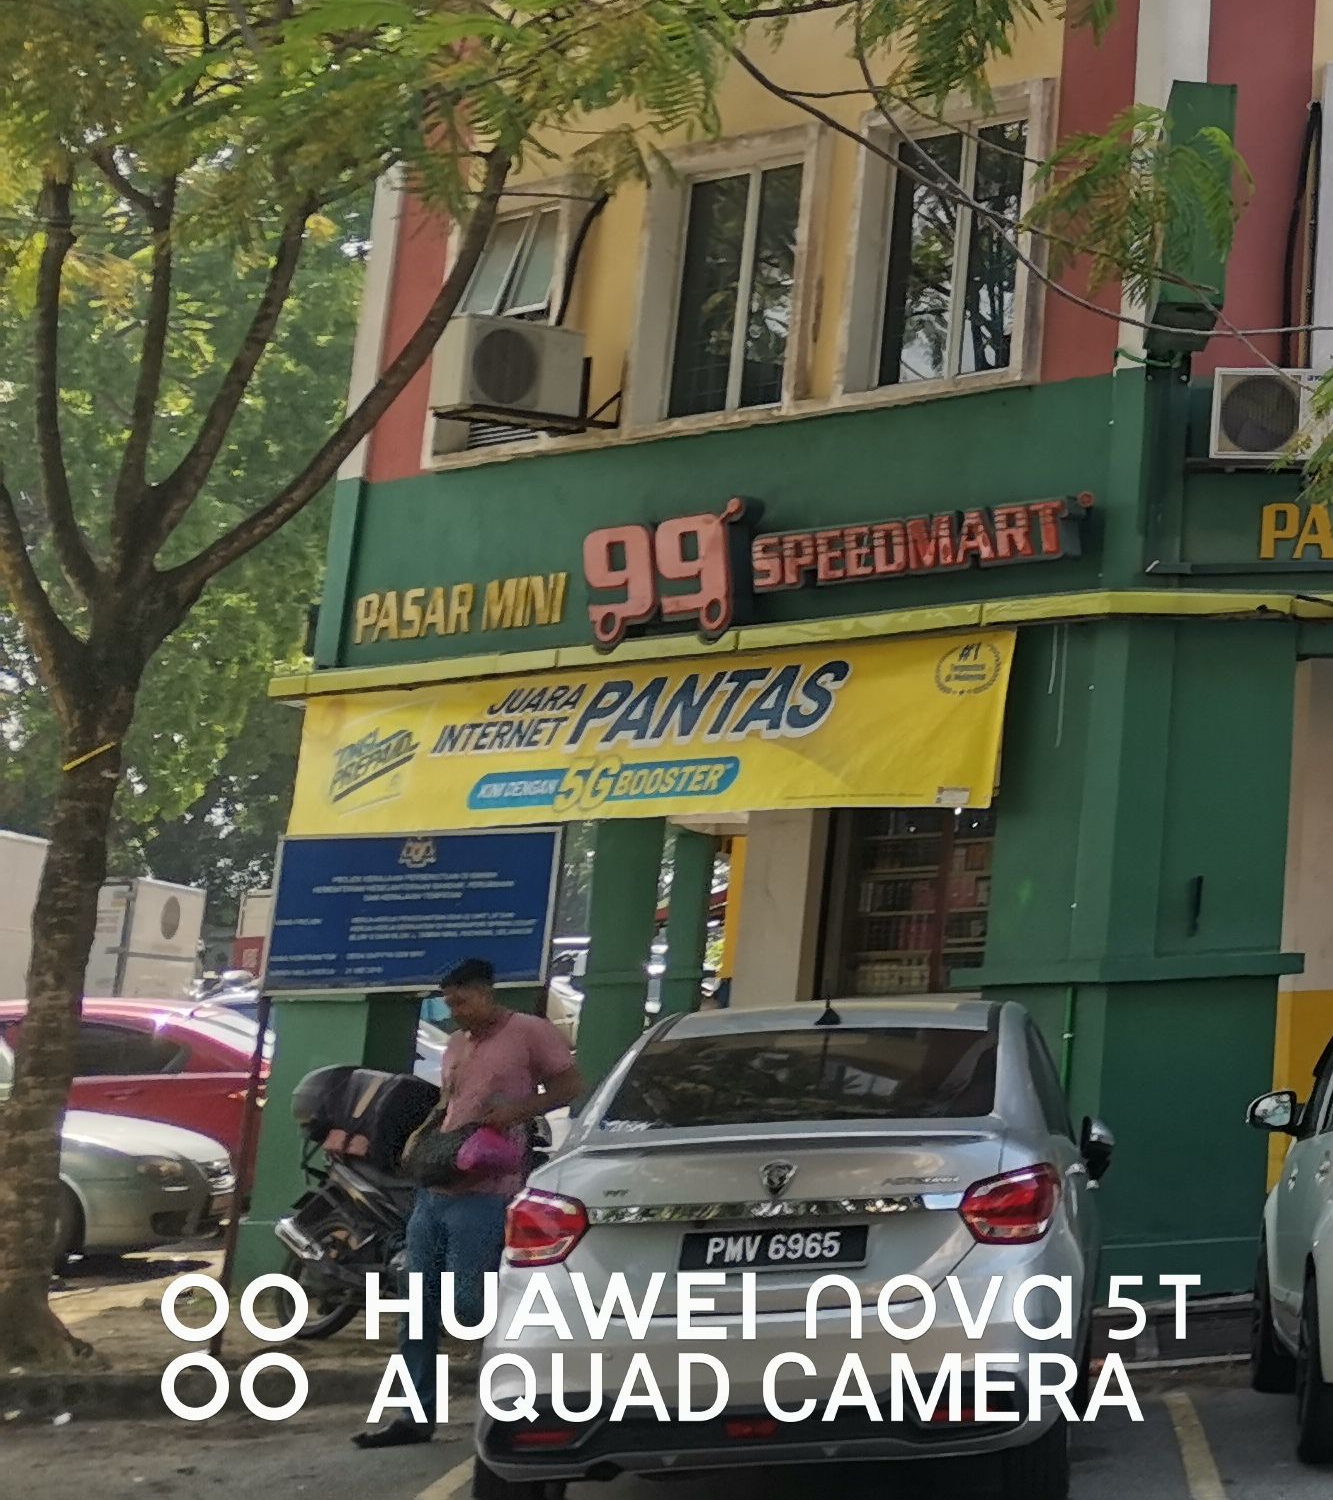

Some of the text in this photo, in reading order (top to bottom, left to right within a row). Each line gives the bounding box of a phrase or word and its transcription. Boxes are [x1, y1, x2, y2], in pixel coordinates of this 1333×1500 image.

[354, 497, 1064, 649] PASAR MINI 99 SPEEDMART
[488, 683, 587, 715] JUARA
[563, 660, 849, 746] PANTAS
[431, 717, 569, 754] INTERNET
[553, 756, 623, 813] 5G
[614, 763, 726, 797] BOOSTER
[706, 1231, 841, 1265] PMV 6965
